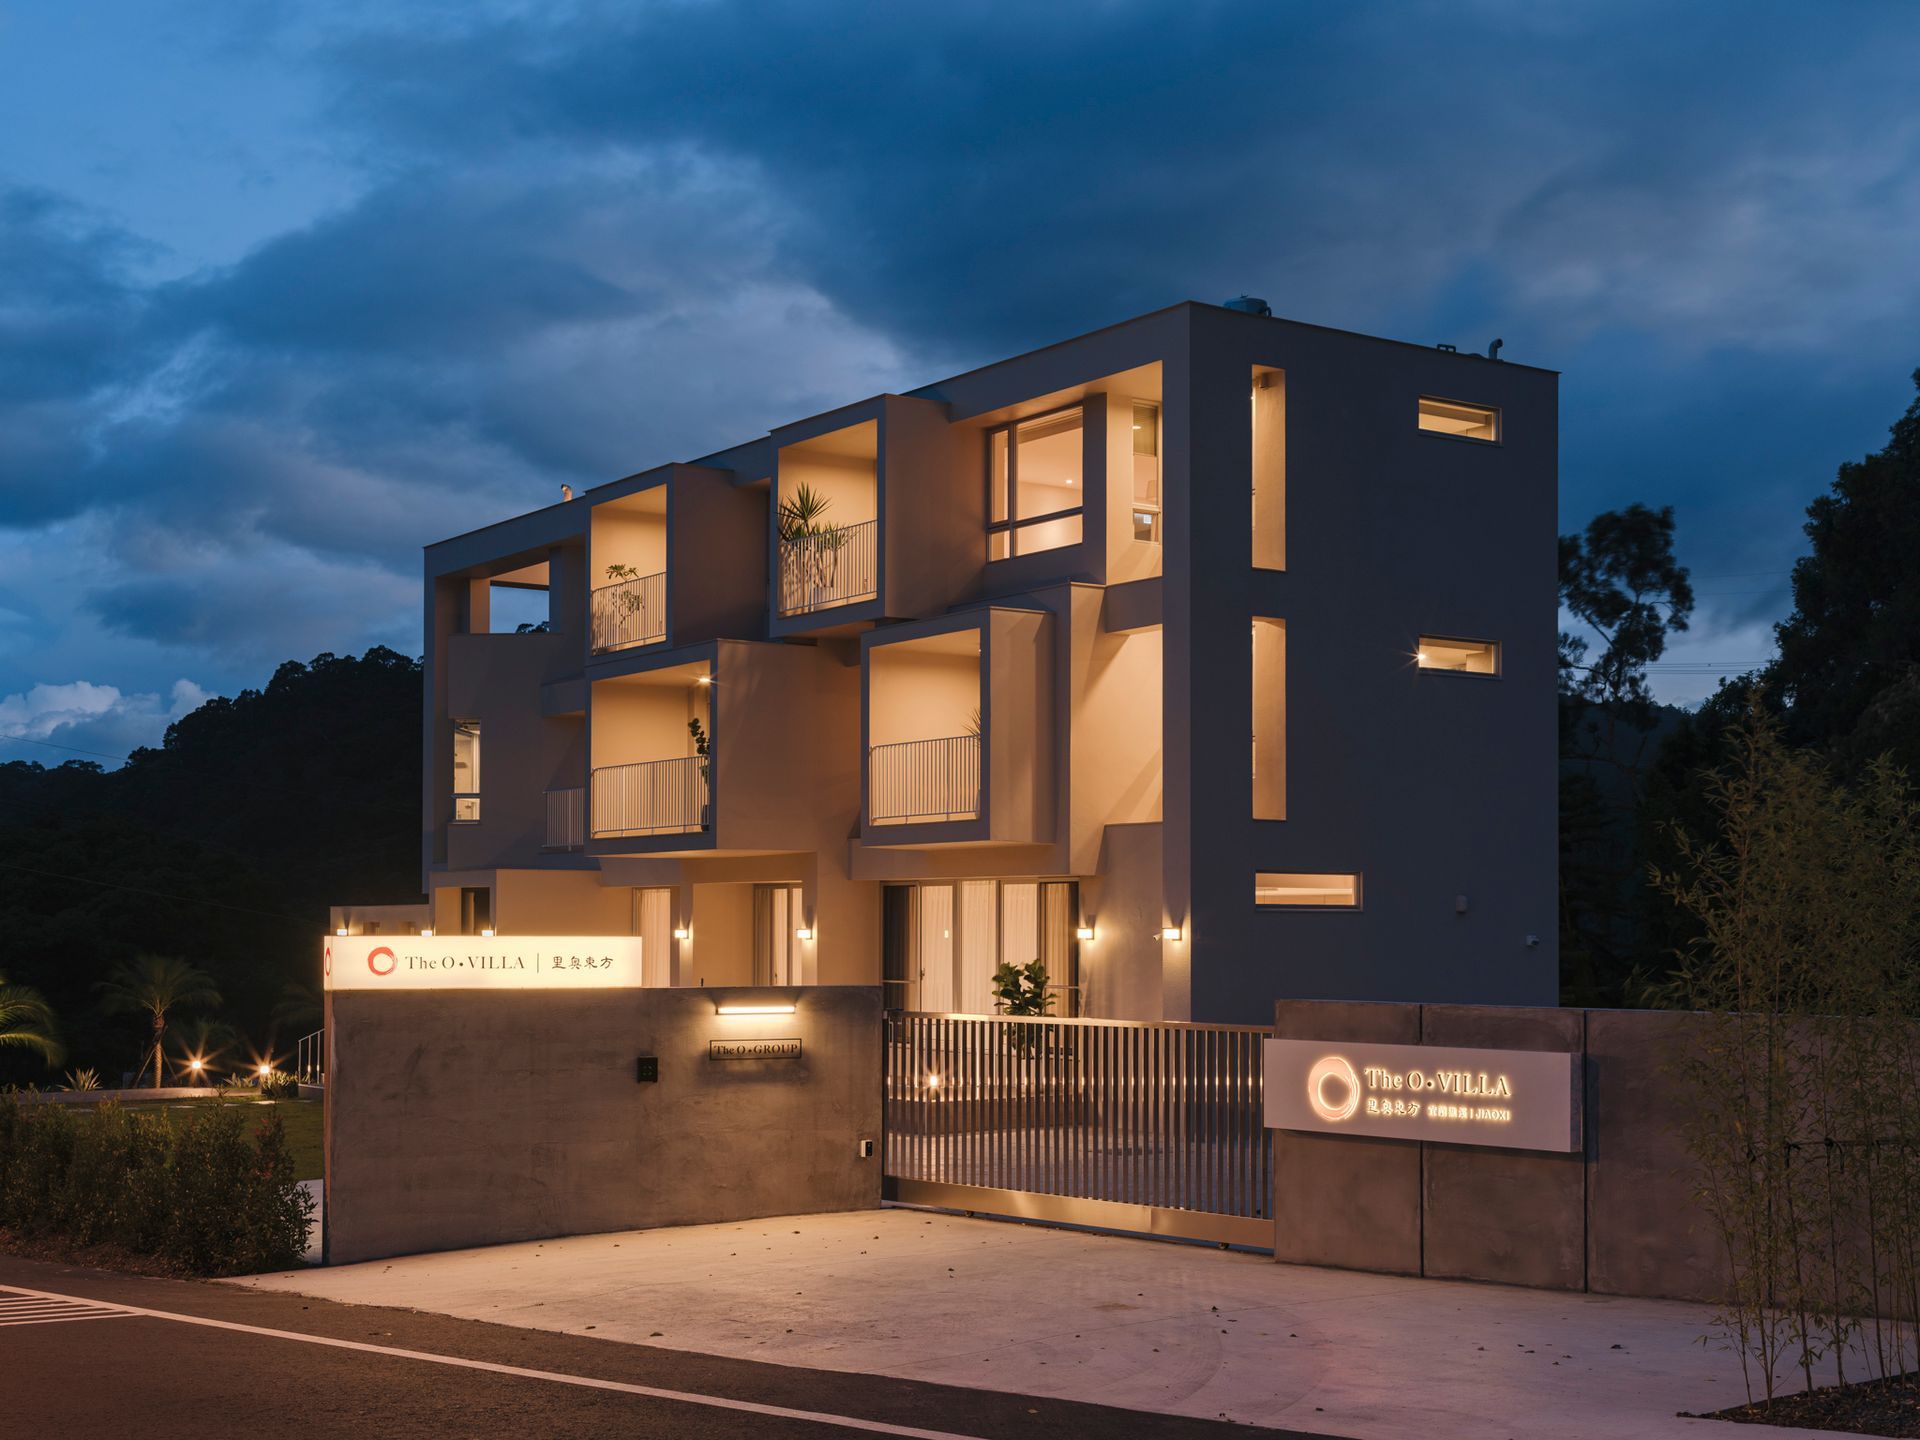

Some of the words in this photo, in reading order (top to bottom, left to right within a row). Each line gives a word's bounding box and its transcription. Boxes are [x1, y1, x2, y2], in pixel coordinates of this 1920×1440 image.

[405, 955, 437, 970] The
[713, 1044, 735, 1055] The
[1364, 1068, 1402, 1089] The
[1475, 1108, 1511, 1121] JIAOXI
